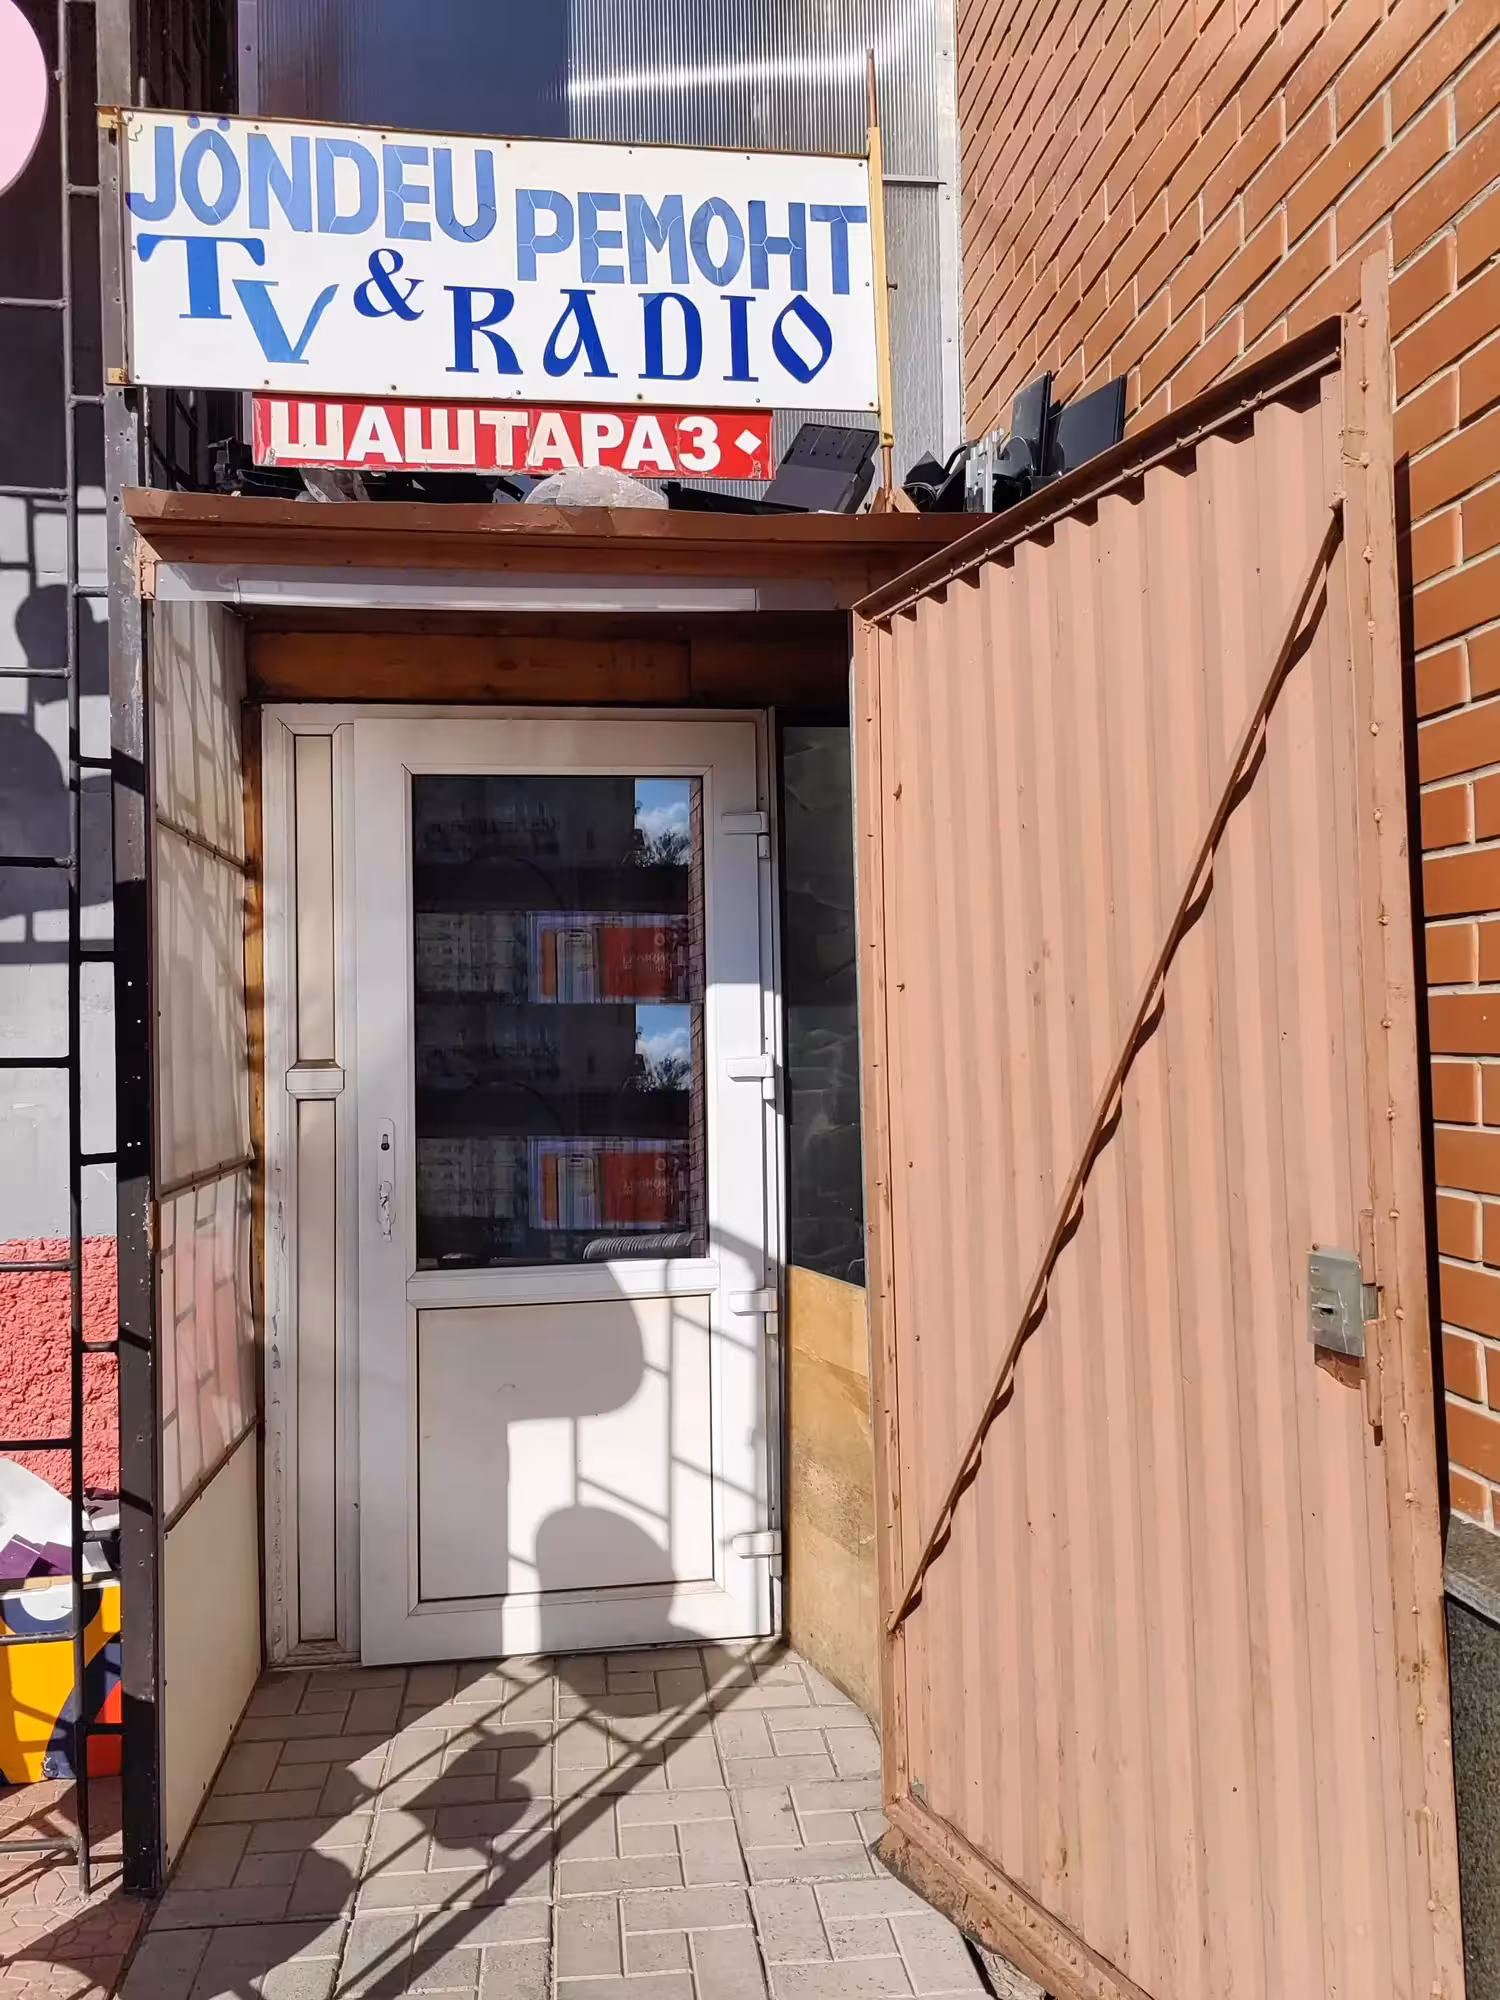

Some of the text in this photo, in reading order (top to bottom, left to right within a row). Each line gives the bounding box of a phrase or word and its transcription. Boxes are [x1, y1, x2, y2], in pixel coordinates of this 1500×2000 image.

[125, 115, 497, 243] JÖNDEU
[515, 187, 868, 295] РЕМОНТ
[136, 233, 833, 384] TV & RADIO
[269, 401, 720, 472] ШАШТАРАЗ
